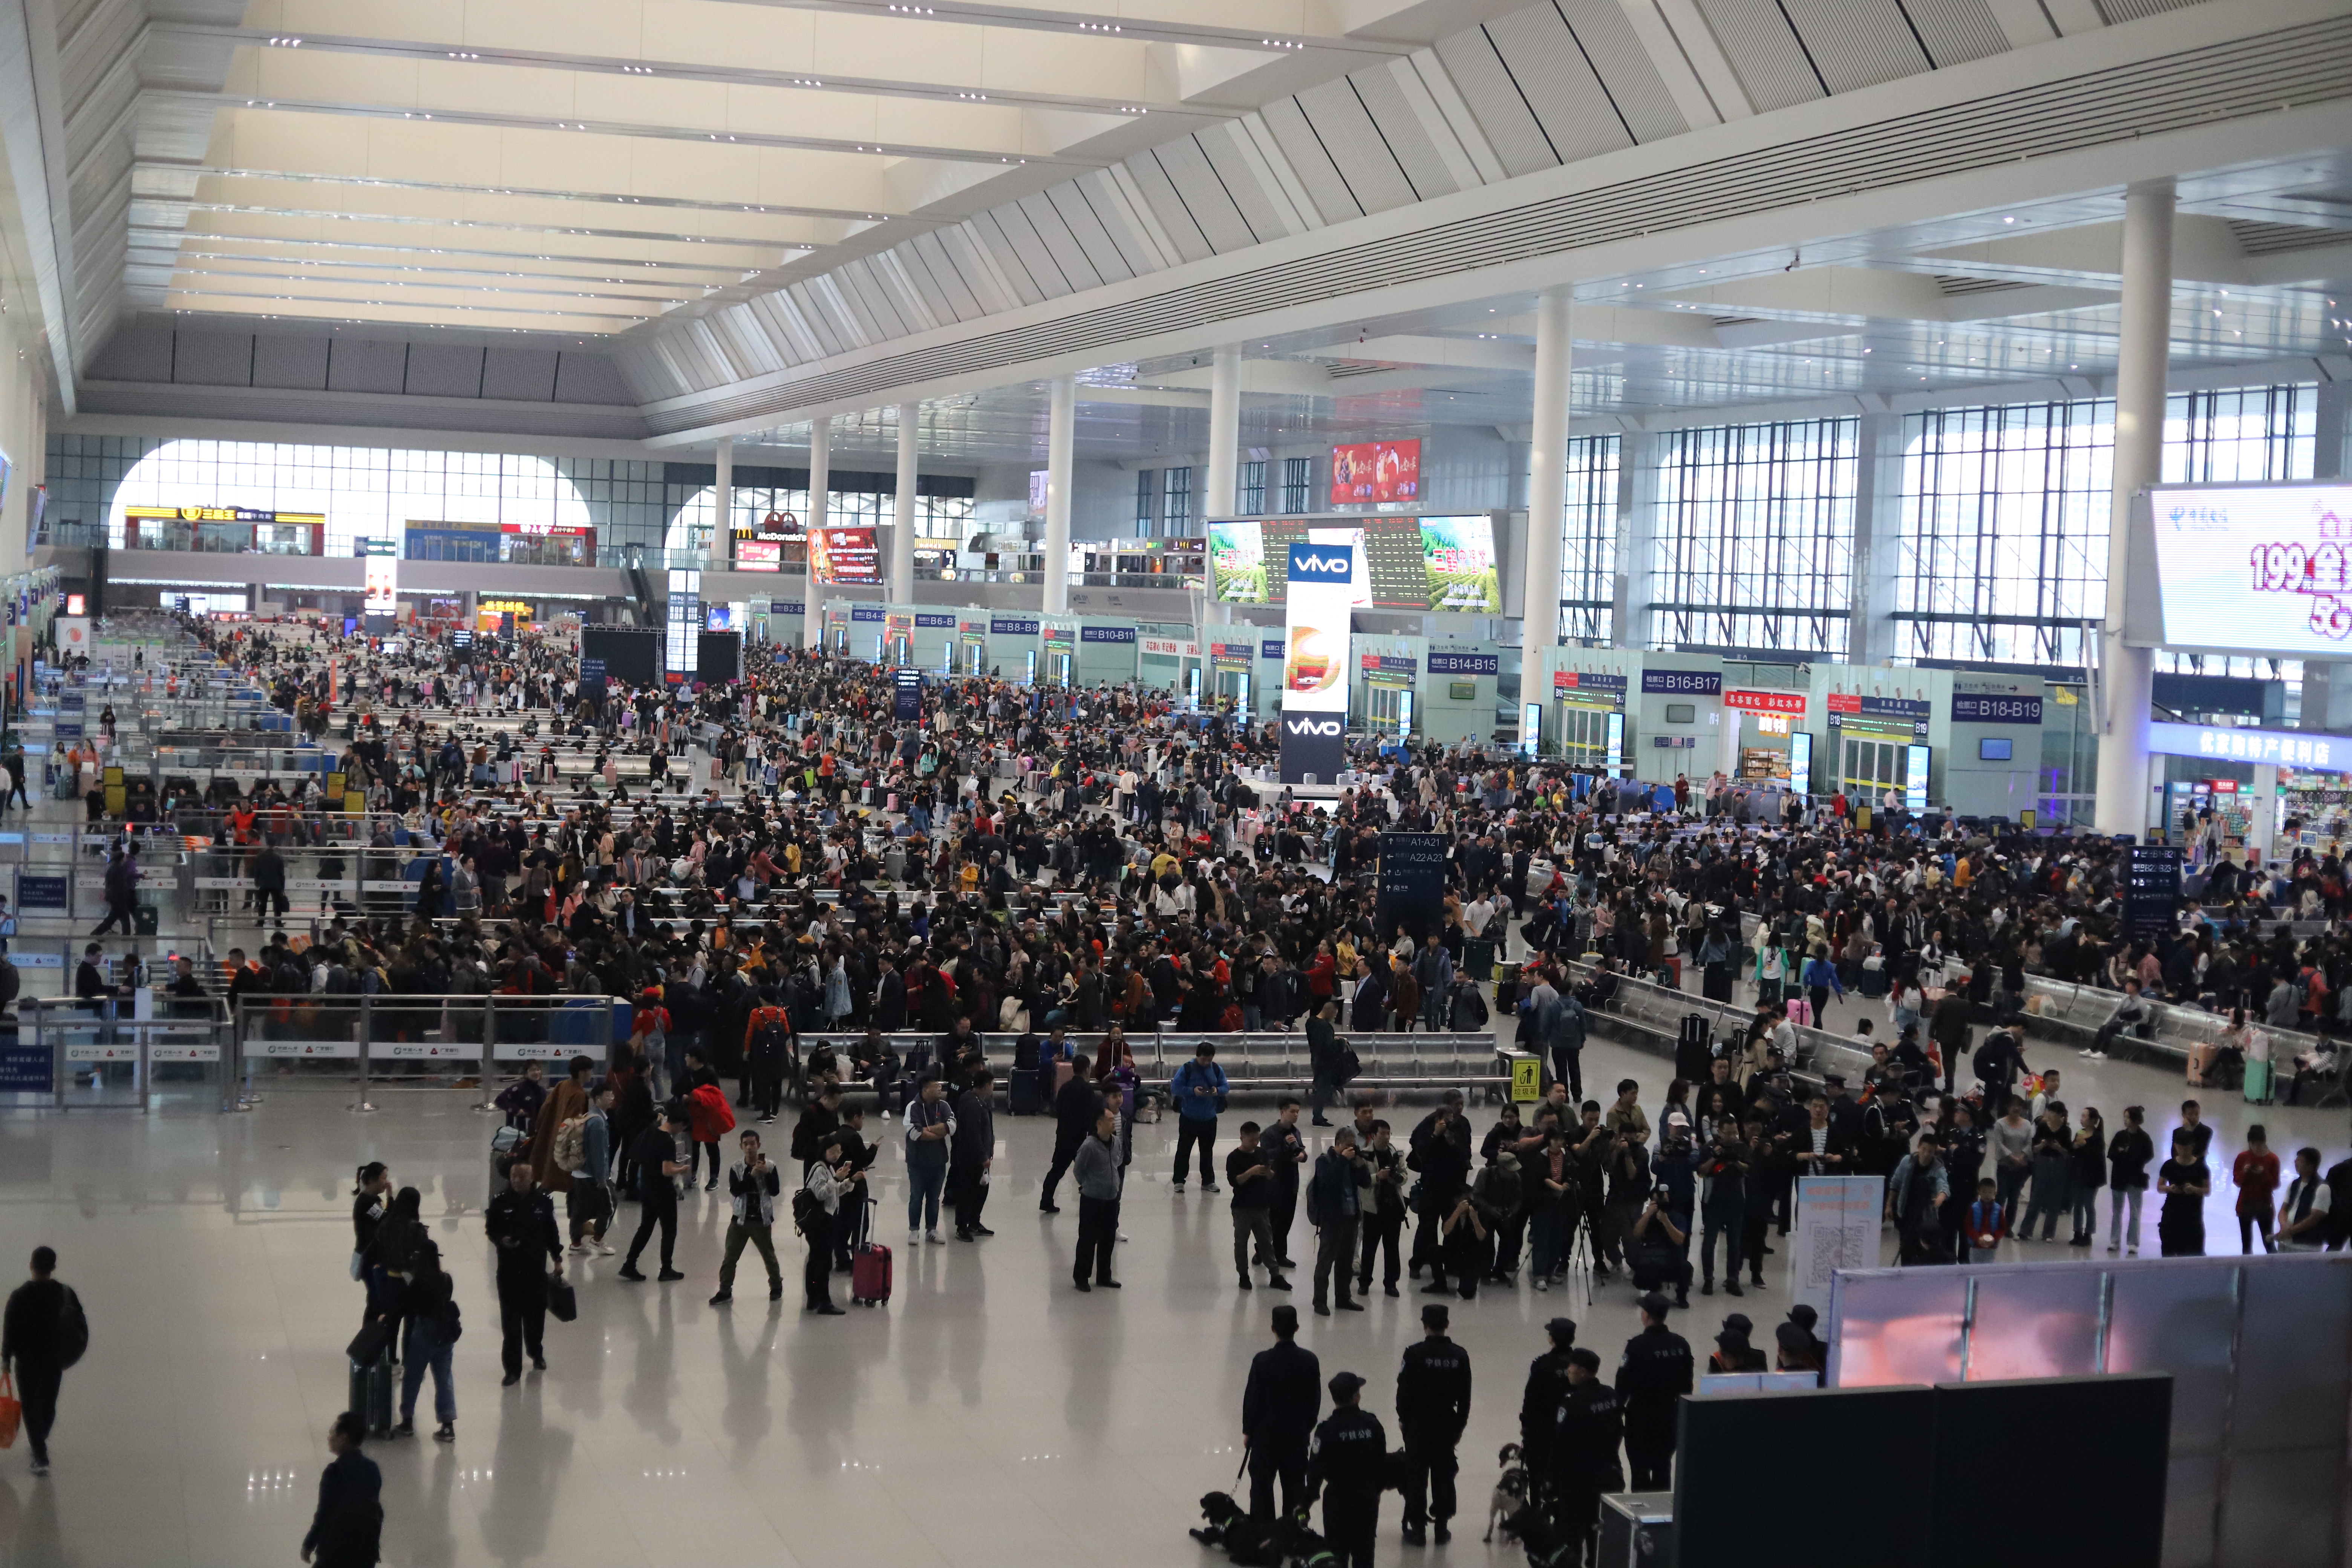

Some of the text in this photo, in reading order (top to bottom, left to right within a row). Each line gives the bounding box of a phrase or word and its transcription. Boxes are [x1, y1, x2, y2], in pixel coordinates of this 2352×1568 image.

[202, 509, 235, 520] 三品王
[757, 532, 807, 542] McDonald's
[1295, 554, 1348, 573] vivo
[866, 611, 886, 620] B4-B
[930, 617, 956, 625] B6-B
[1007, 623, 1038, 632] B8-B9
[1098, 631, 1133, 640] B10-B11
[1147, 641, 1160, 651] 不忘初心
[1162, 642, 1176, 652] 牢记使命
[1449, 658, 1496, 671] B14-B15
[1667, 675, 1719, 690] B16-B17
[1616, 694, 1625, 703] B17
[1729, 694, 1802, 709] 喜客面包 彩虹水果
[1957, 700, 2040, 717] 检票口 B18-B19
[1830, 714, 1840, 725] B18
[1287, 717, 1340, 735] vivo
[1915, 723, 1927, 734] B19
[2201, 732, 2330, 764] 优家购特产便利店
[1411, 838, 1439, 846] A1-A21
